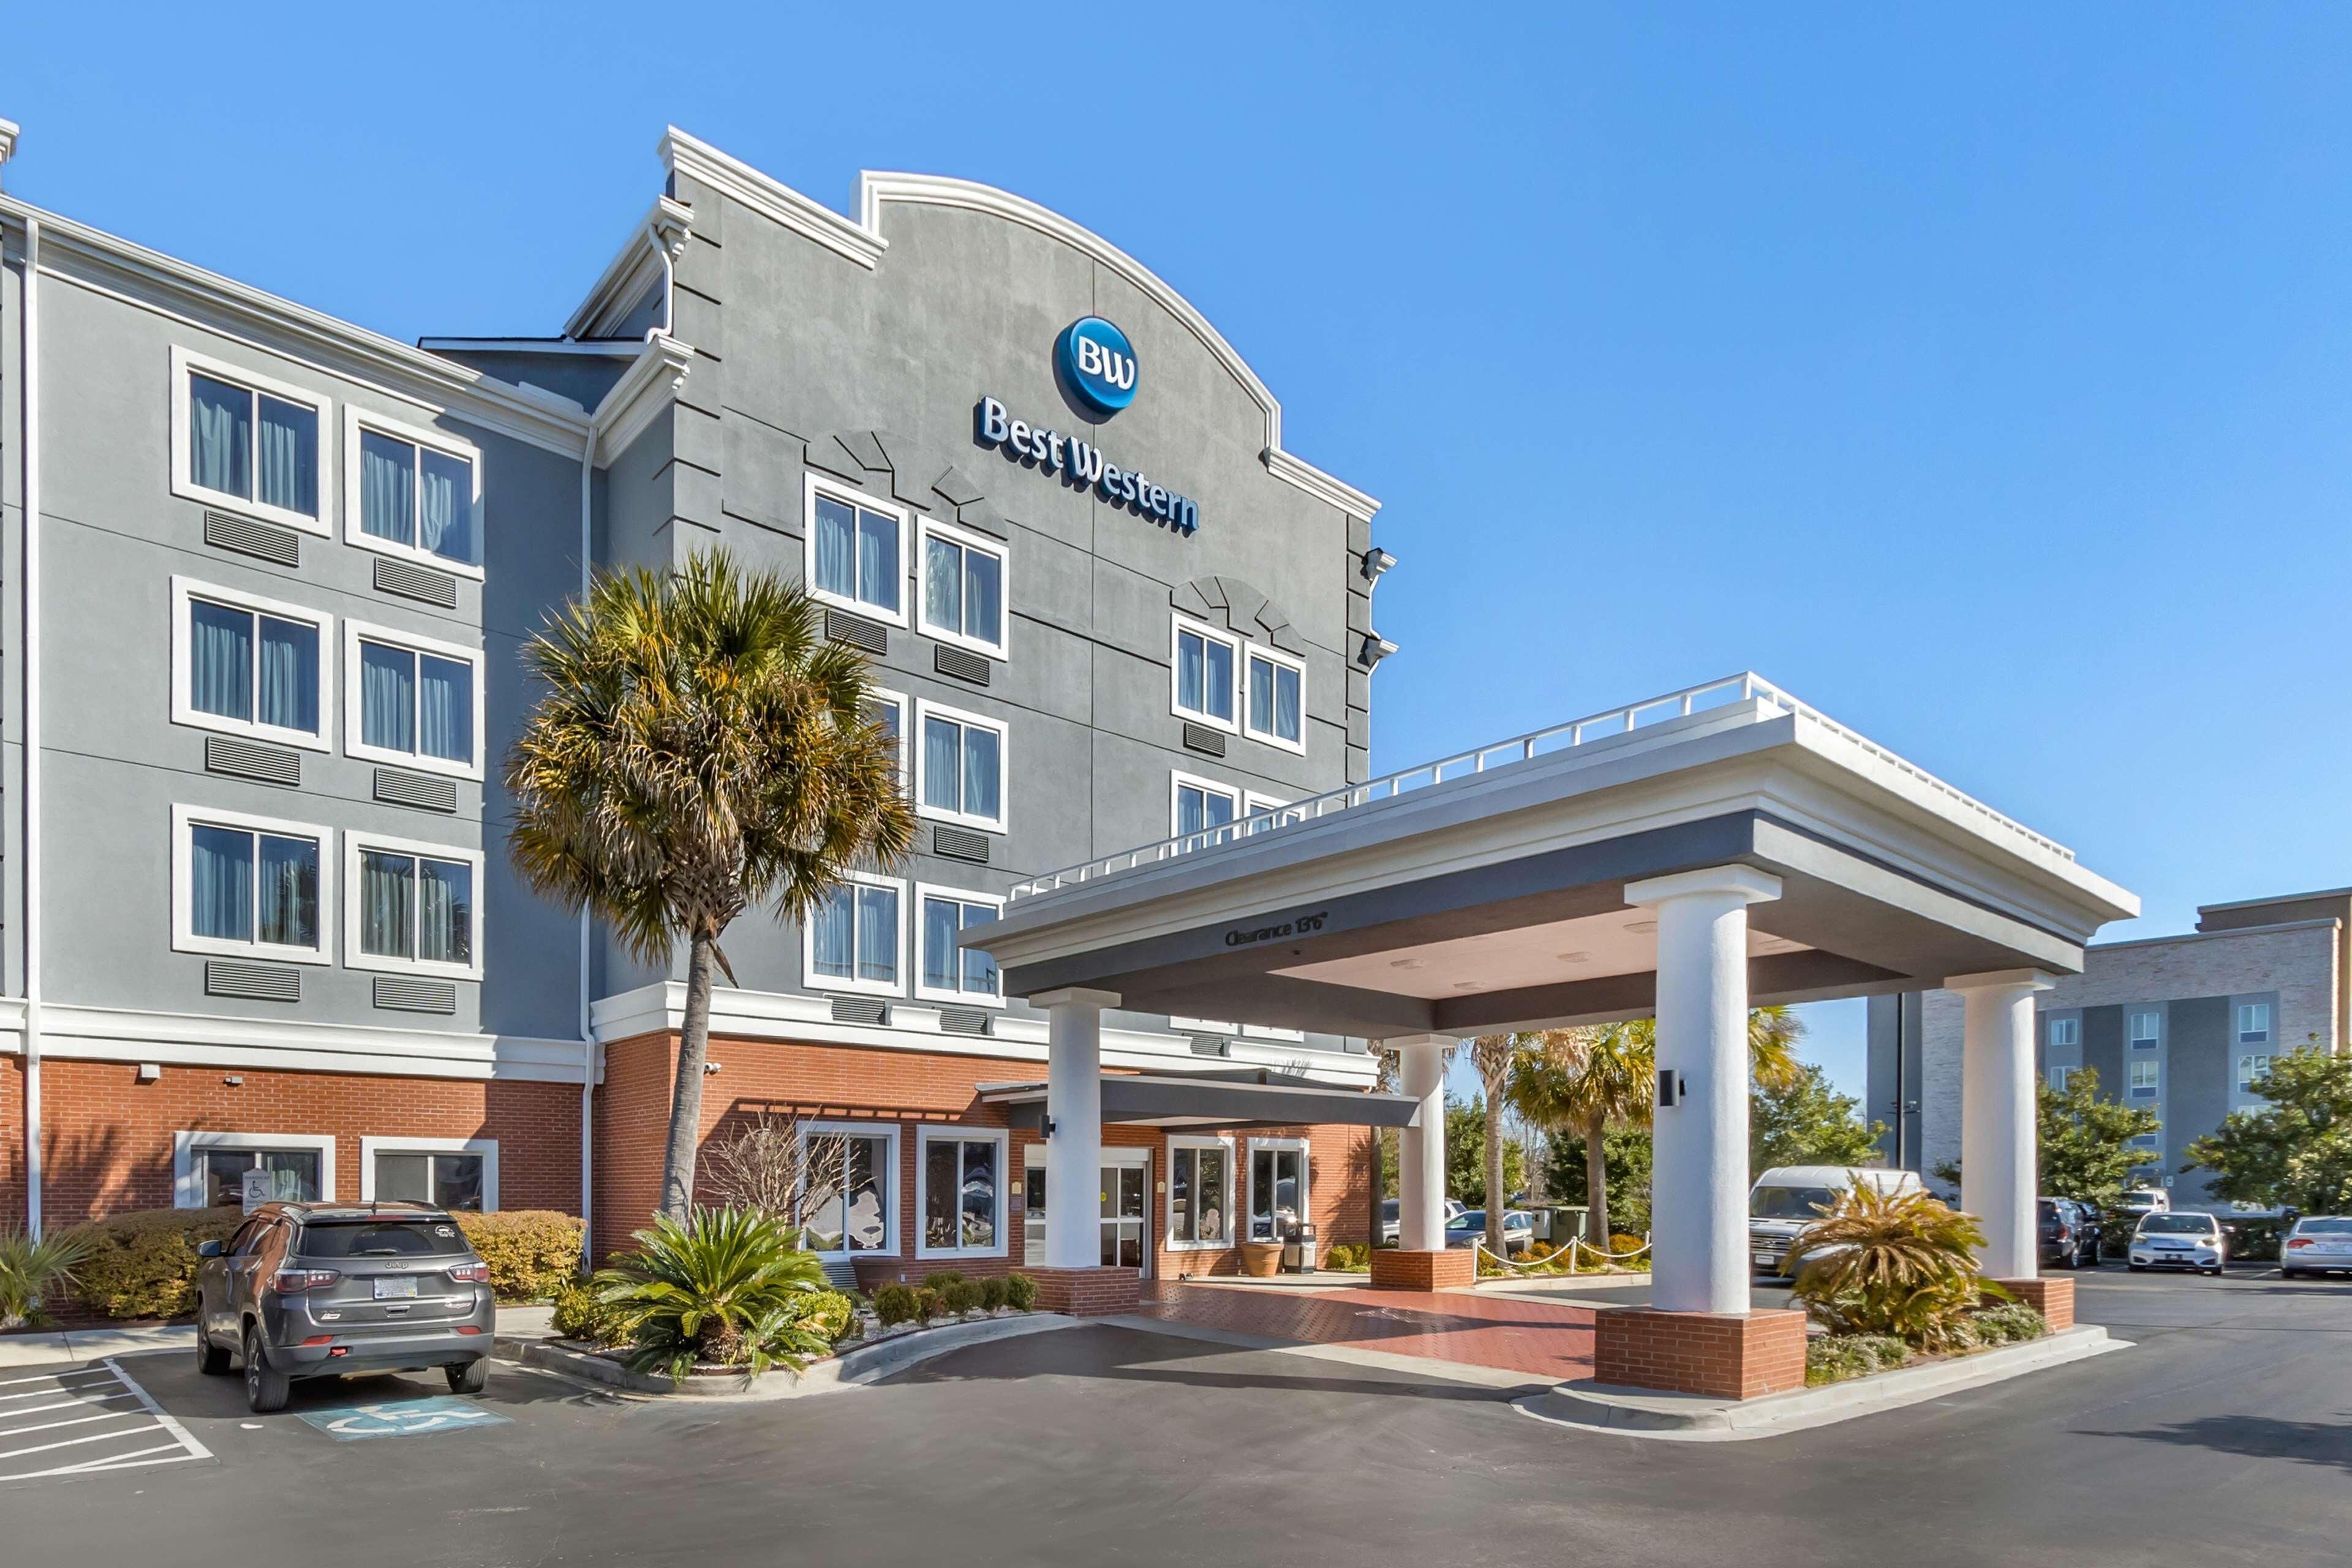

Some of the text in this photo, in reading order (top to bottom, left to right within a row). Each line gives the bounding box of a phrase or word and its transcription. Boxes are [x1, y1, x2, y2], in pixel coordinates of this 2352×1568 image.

[1078, 335, 1136, 390] BW
[981, 395, 1199, 532] Best Western
[1226, 923, 1292, 946] Clearance
[385, 1261, 408, 1270] Jeep
